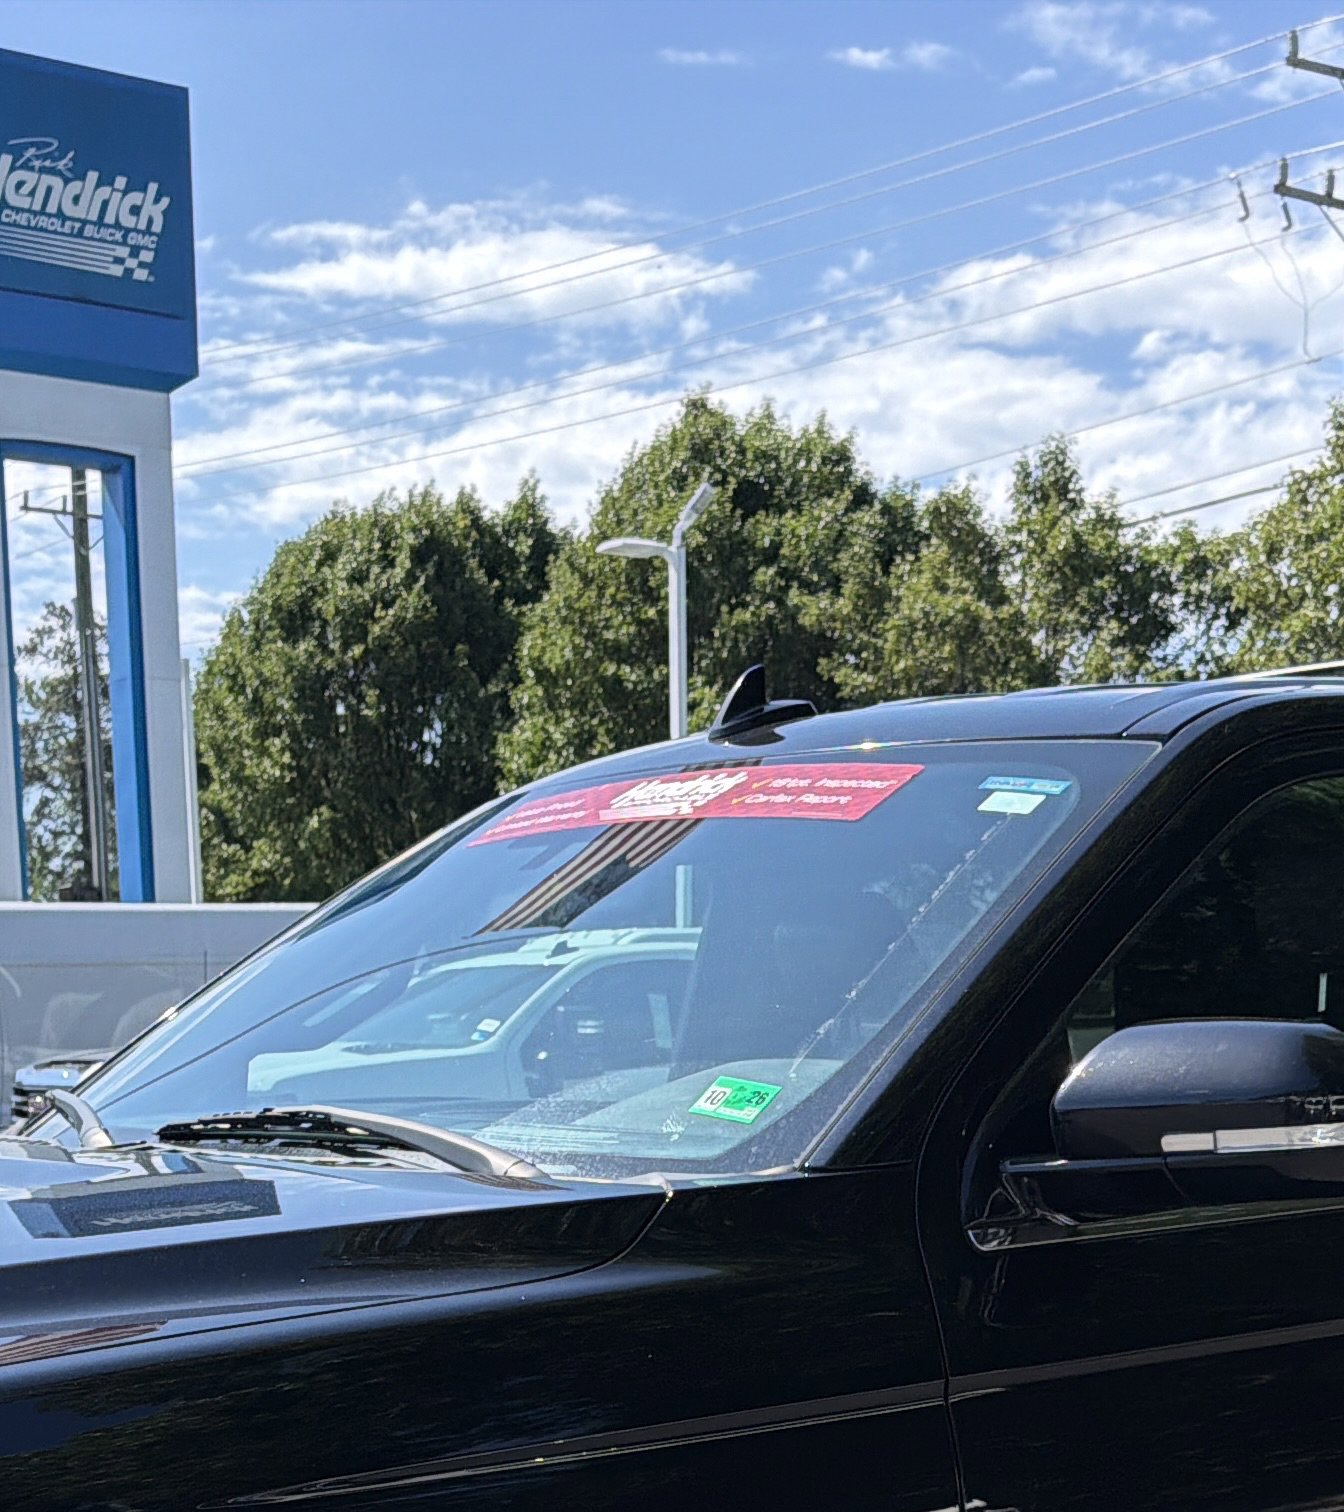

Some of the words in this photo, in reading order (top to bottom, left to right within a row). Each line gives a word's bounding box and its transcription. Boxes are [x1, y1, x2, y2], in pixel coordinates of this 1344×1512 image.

[0, 208, 82, 235] CHEVROLET
[83, 223, 125, 242] BUICK
[127, 231, 158, 249] GMC
[703, 1089, 727, 1106] 10
[744, 1090, 770, 1106] 26
